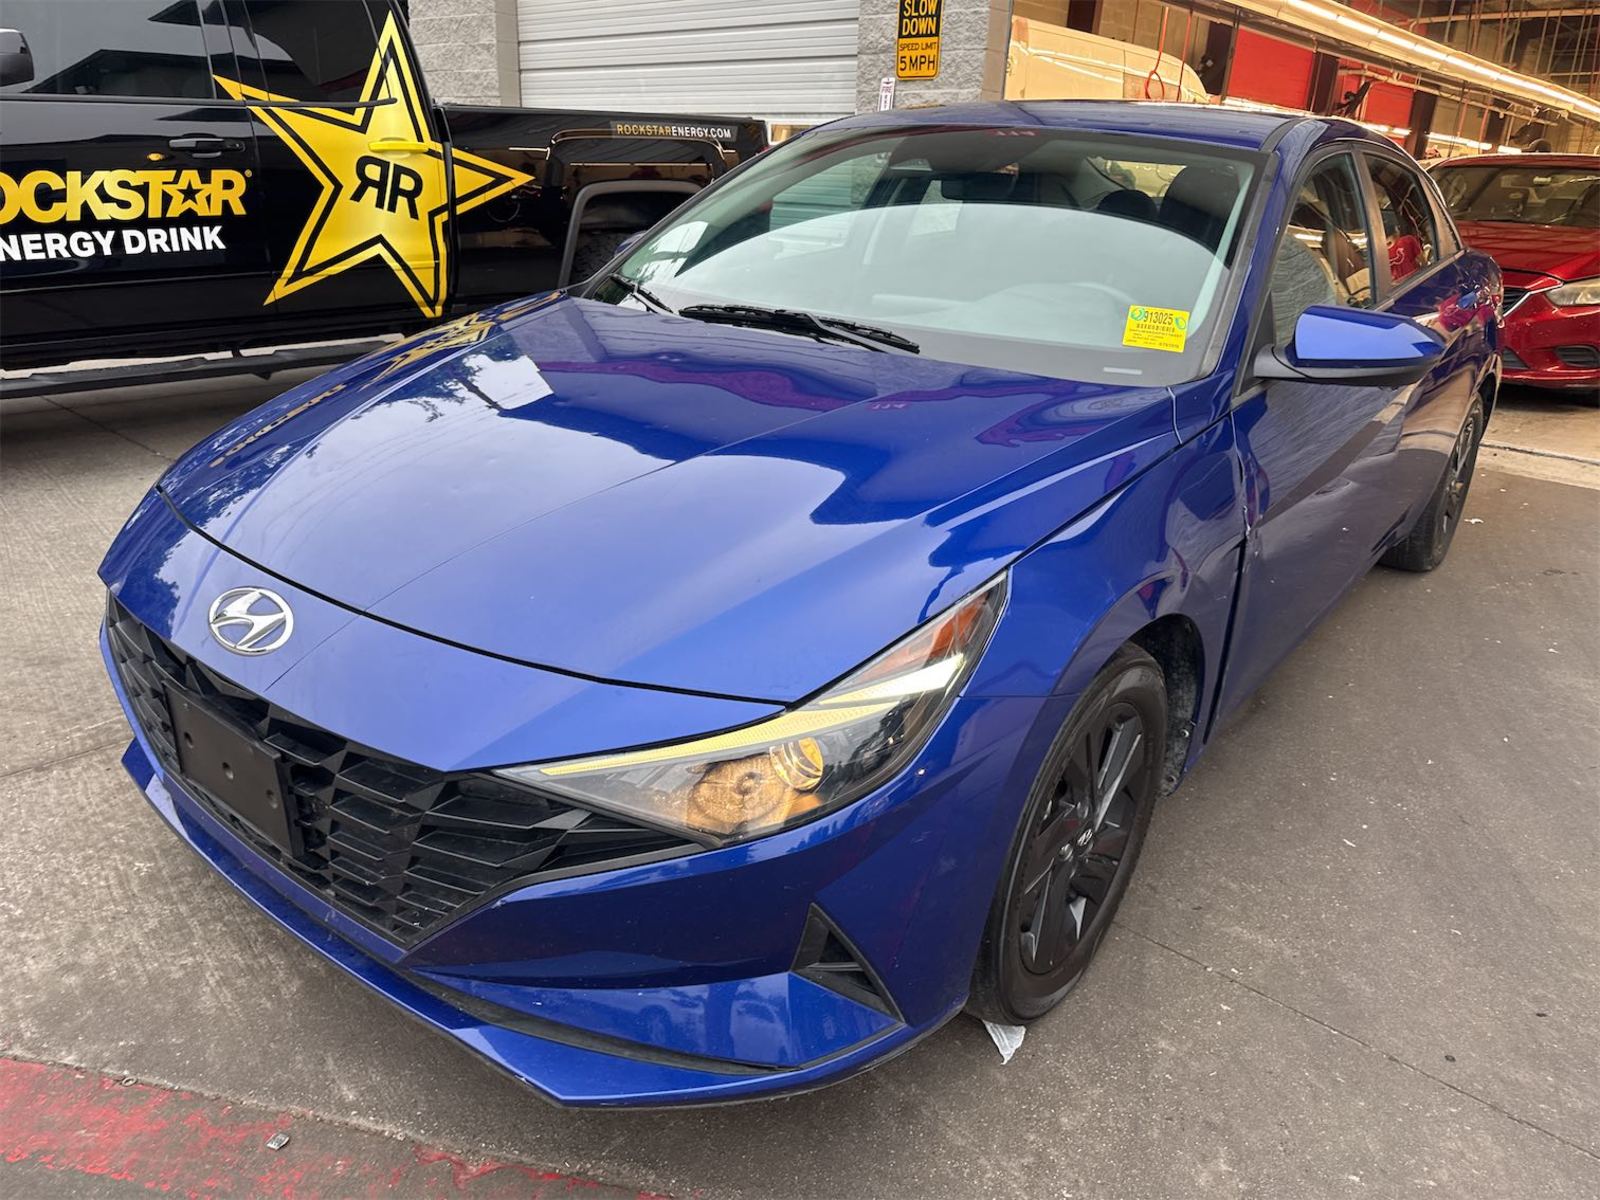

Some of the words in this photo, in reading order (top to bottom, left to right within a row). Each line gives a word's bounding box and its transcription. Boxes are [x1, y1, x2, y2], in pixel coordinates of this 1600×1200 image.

[903, 0, 938, 16] SLOW
[902, 17, 937, 35] DOWN
[899, 43, 920, 51] SPEED
[921, 42, 937, 50] LIMIT
[899, 56, 907, 71] 5
[909, 54, 936, 71] MPH
[616, 124, 732, 138] ROCKSTARENERGY.COM
[122, 225, 227, 255] DRINK
